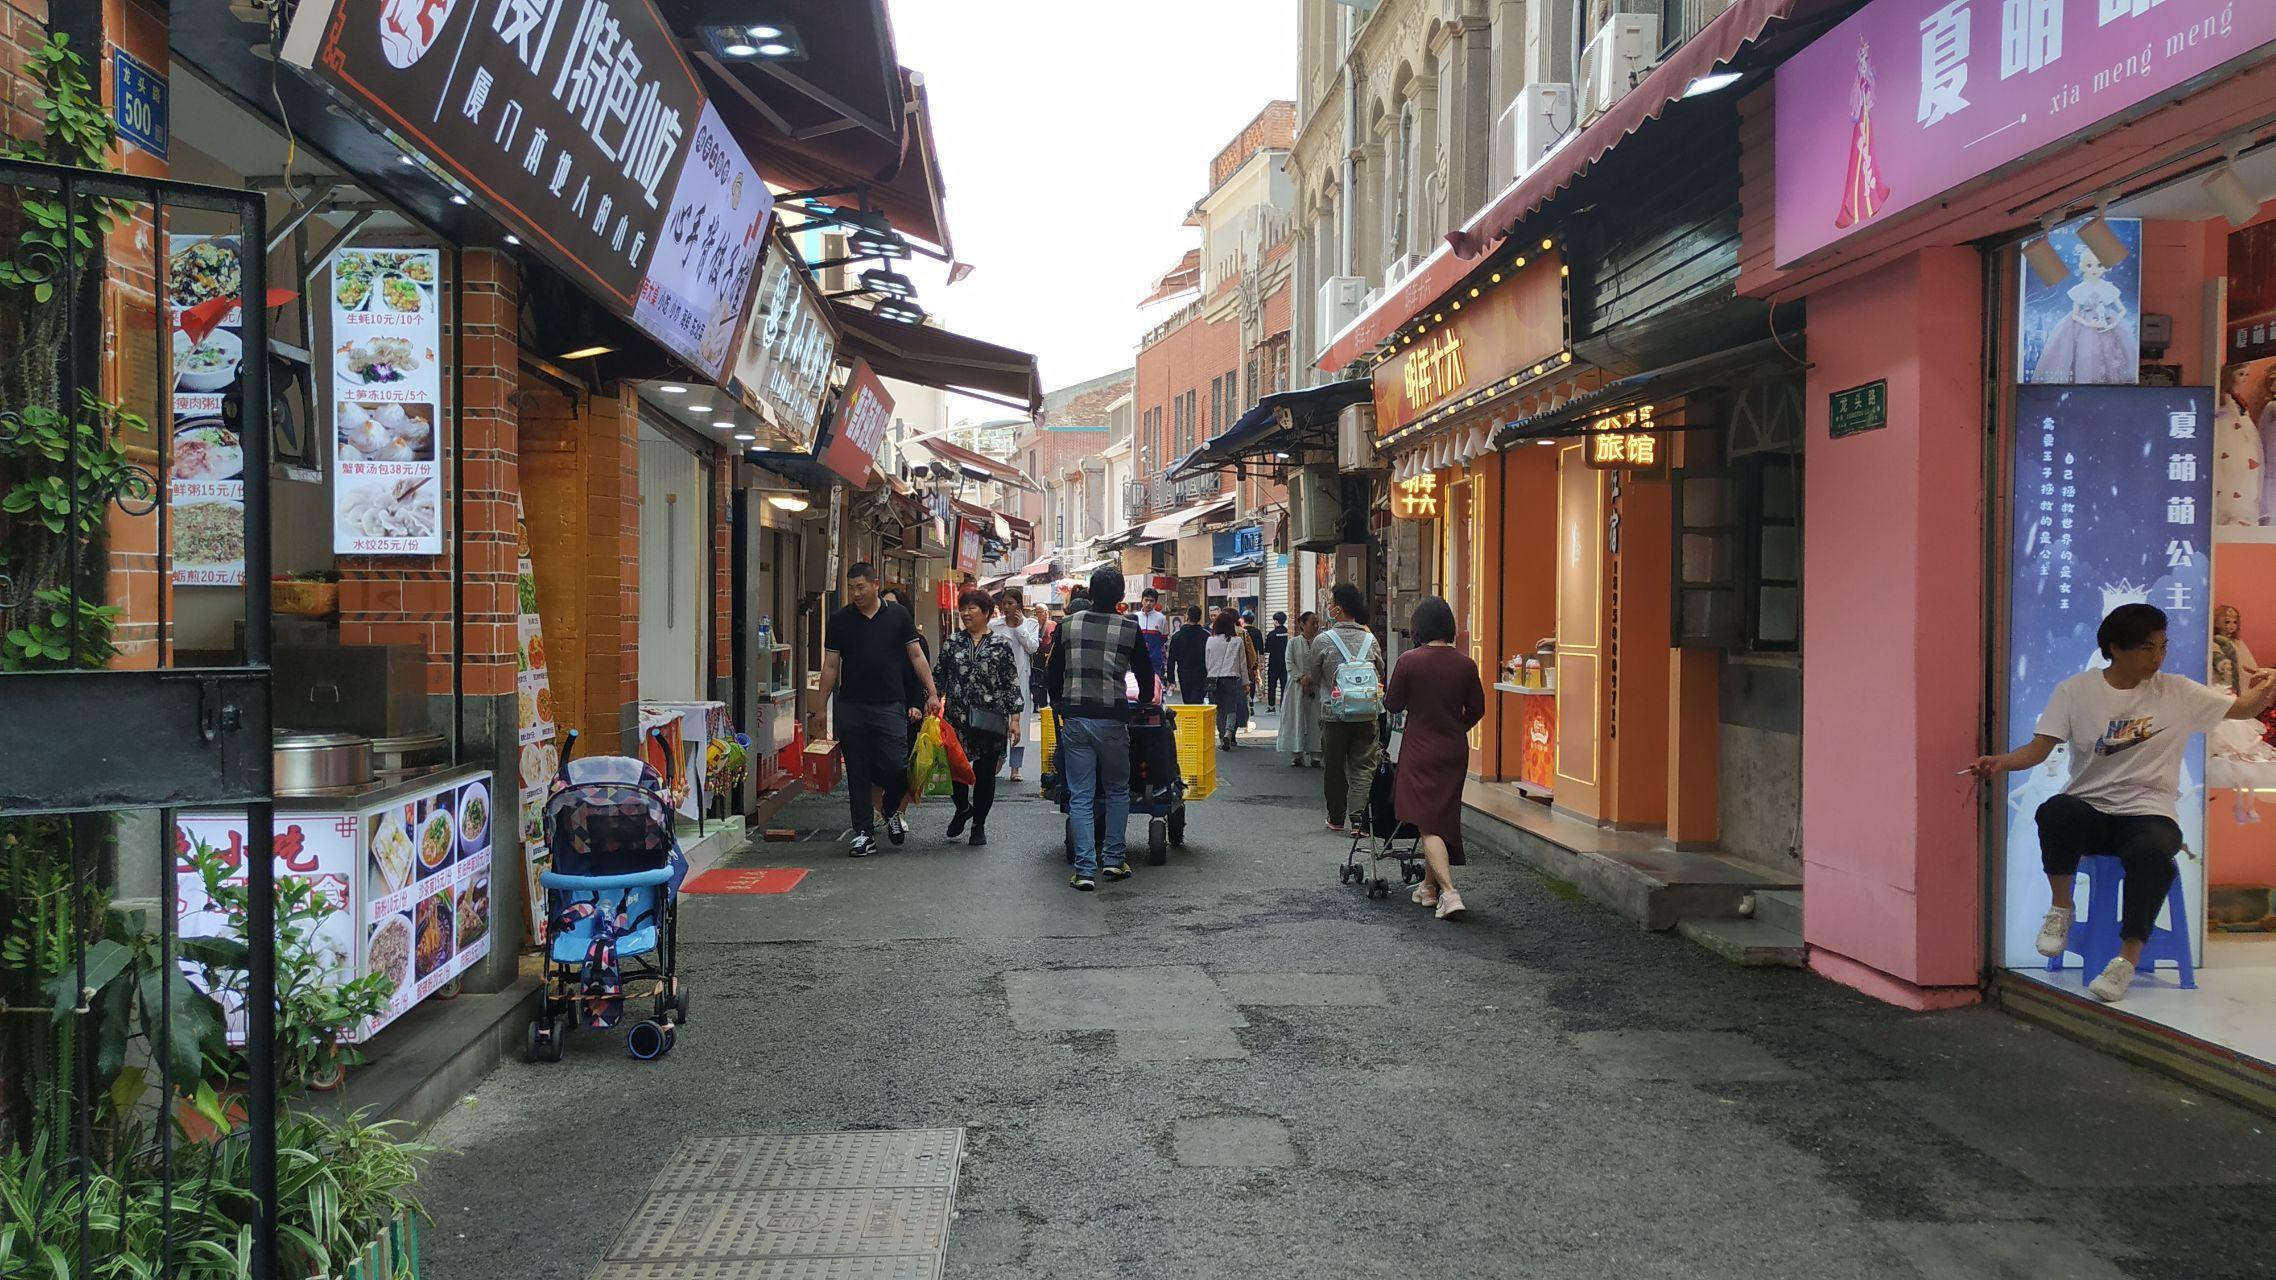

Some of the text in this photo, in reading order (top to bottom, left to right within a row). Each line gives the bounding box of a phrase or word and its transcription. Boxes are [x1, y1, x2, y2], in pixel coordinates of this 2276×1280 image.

[2050, 1, 2233, 115] xia meng meng
[122, 66, 161, 104] 龙头路
[125, 91, 152, 136] 500
[462, 65, 647, 268] 厦门本地人的小吃
[346, 312, 424, 326] 生蚝10元/10个
[1403, 328, 1465, 410] 明年十六
[344, 389, 428, 401] 土笋冻10元/5个
[1595, 433, 1655, 464] 旅馆
[342, 463, 431, 477] 蟹黄汤包38元/份
[1401, 473, 1437, 493] 明年
[1401, 496, 1437, 514] 十六
[2039, 417, 2056, 576] 需要王子拯救的是公主
[2165, 410, 2197, 611] 夏萌萌公主
[353, 538, 419, 551] 水饺25元/份
[2059, 451, 2076, 609] 自己拯救世界的是女王
